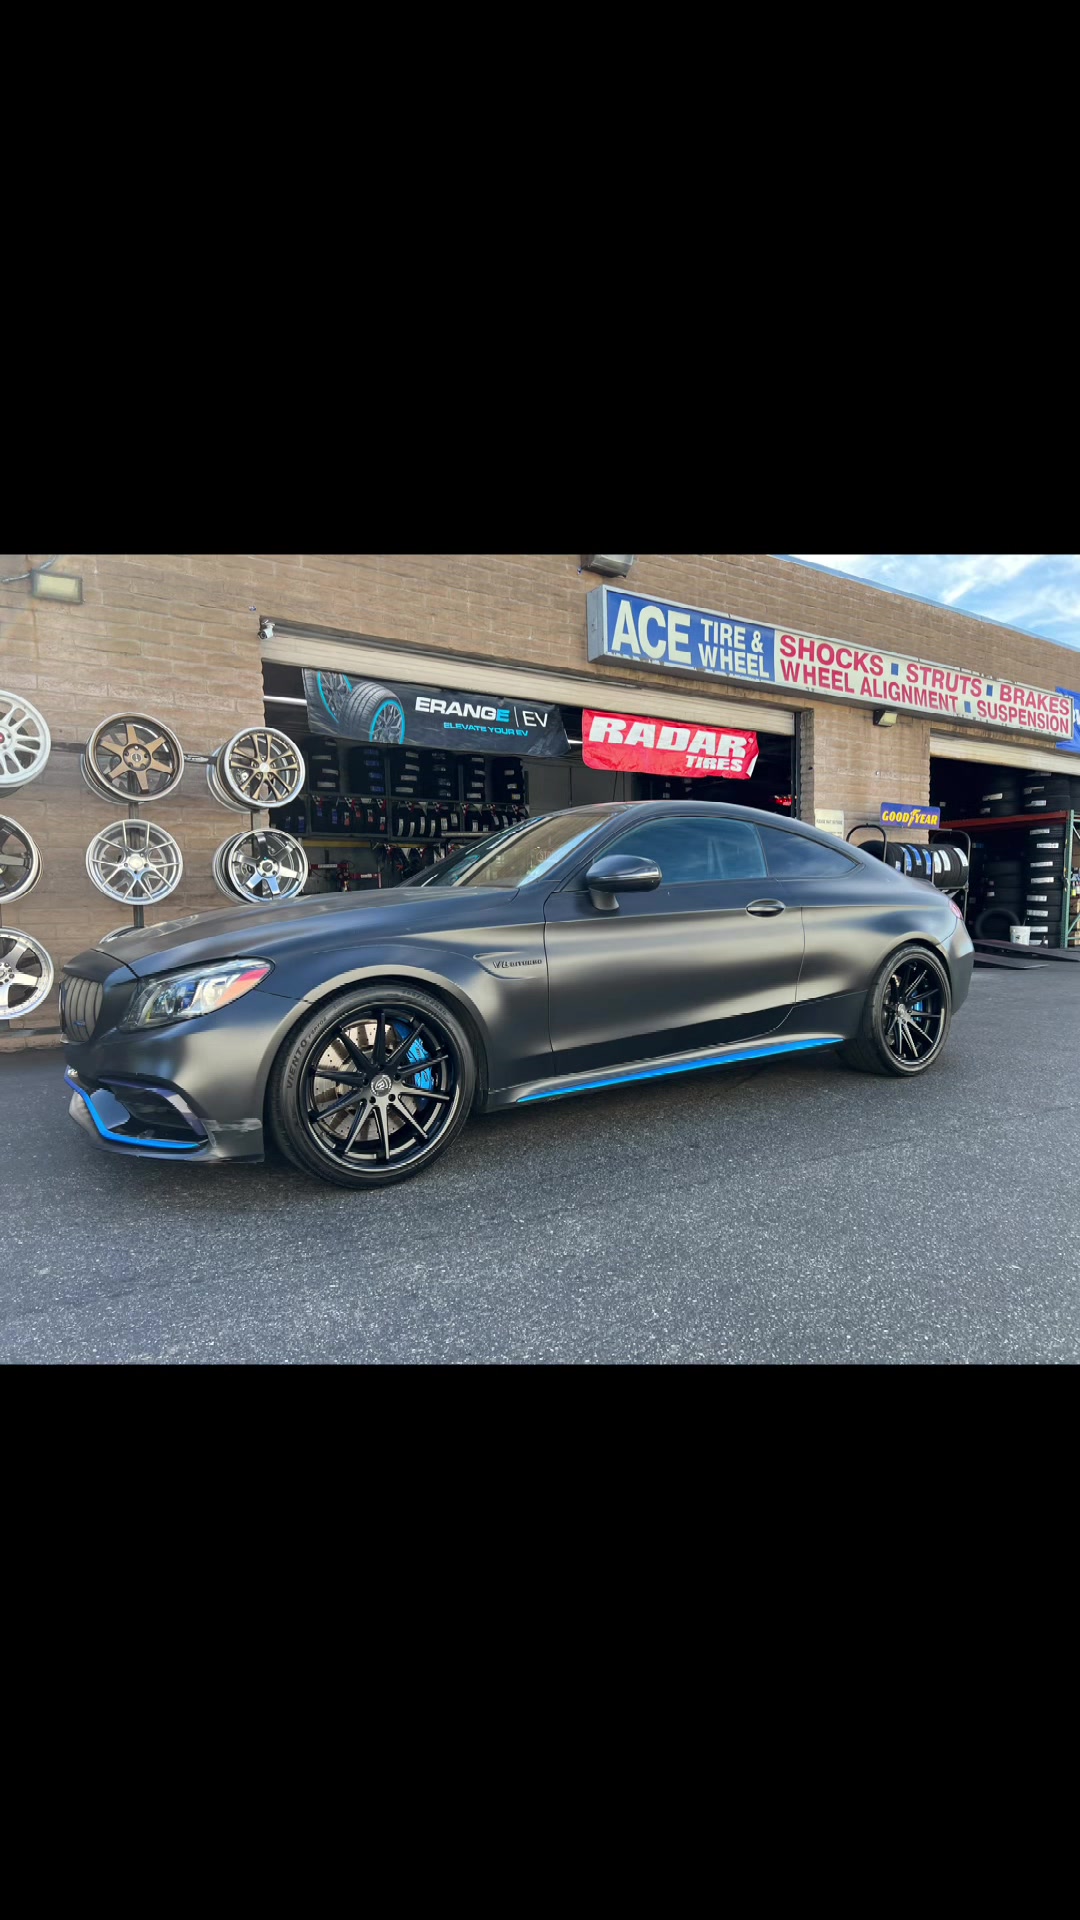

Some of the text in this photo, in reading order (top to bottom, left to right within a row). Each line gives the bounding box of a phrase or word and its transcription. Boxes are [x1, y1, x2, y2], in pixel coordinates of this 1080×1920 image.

[611, 599, 692, 664] ACE
[700, 618, 764, 653] TIRE &
[698, 643, 770, 678] WHEEL
[779, 634, 1070, 715] SHOCKS STRUTS BRAKES
[415, 696, 548, 727] ERANGE EV
[780, 658, 855, 693] WHEEL
[860, 676, 959, 713] ALIGNMENT
[977, 700, 1069, 734] SUSPENSION
[443, 722, 529, 737] ELEVATE YOUR EV
[588, 716, 748, 758] RADAR
[686, 755, 743, 772] TIRES
[881, 809, 939, 827] GOODYEAR
[286, 1039, 308, 1089] VIENTO
